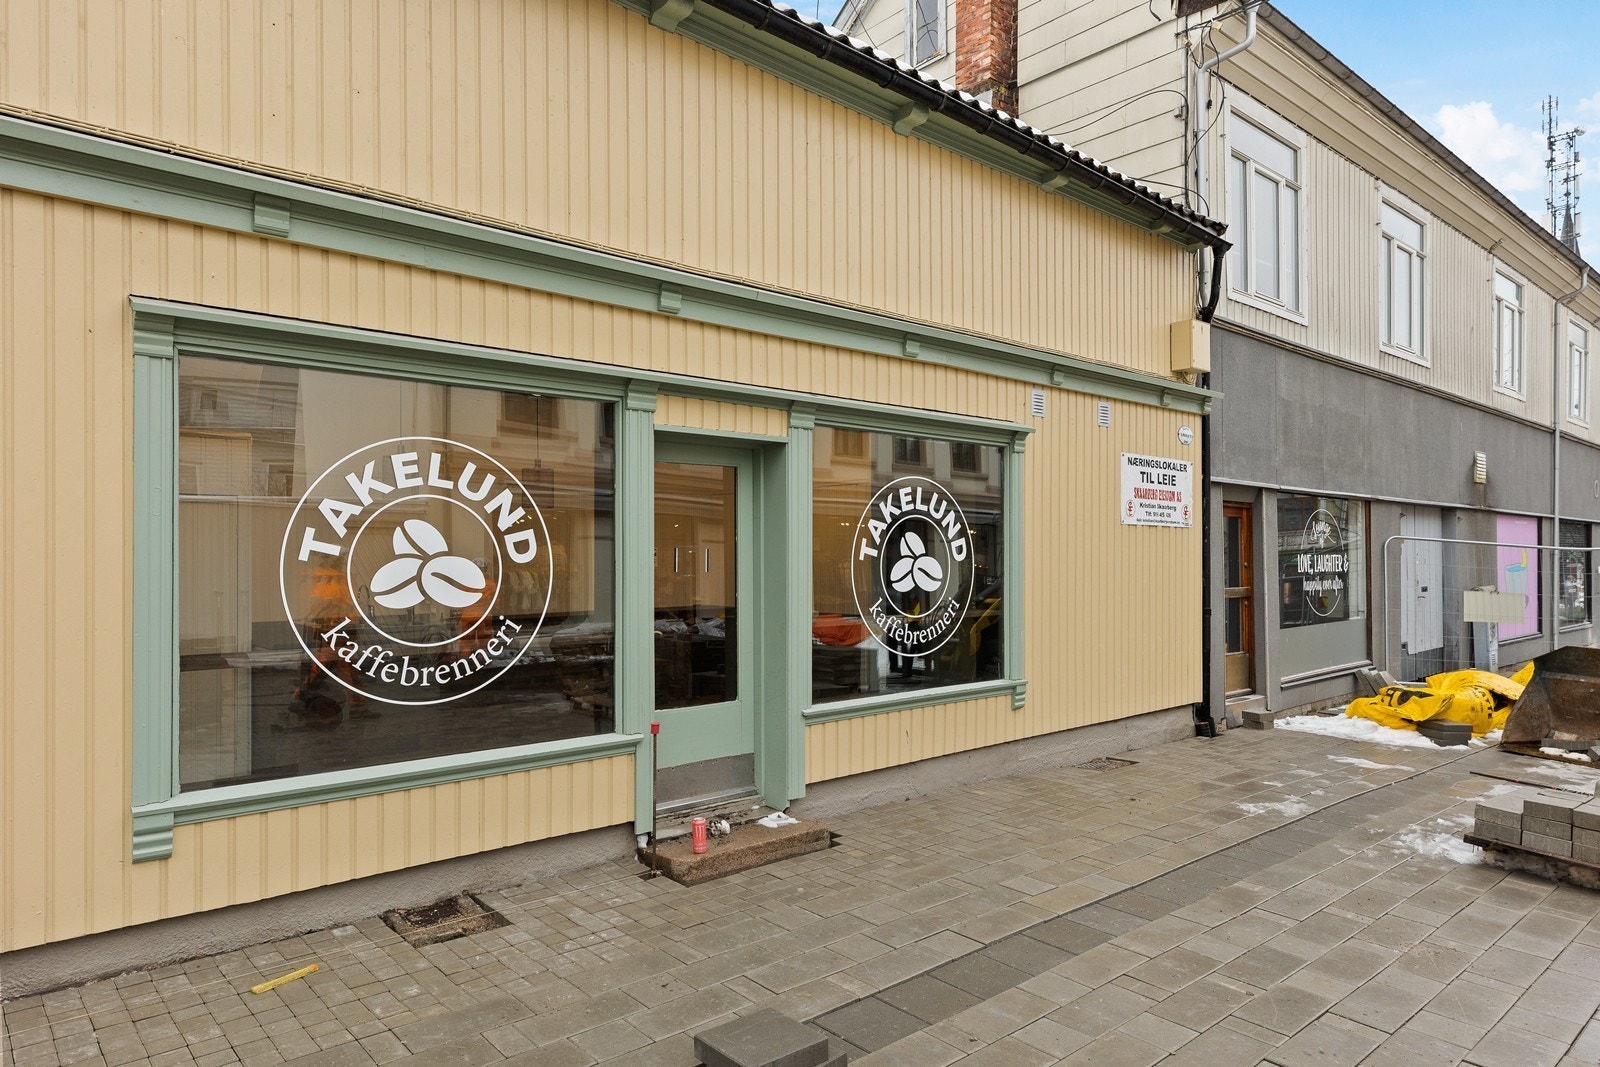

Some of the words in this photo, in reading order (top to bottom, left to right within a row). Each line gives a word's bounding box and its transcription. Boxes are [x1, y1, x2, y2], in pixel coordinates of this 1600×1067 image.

[1127, 456, 1188, 473] NÆRINGSLOKALER
[1140, 471, 1155, 484] TIL
[1157, 473, 1177, 486] LEIE
[298, 451, 537, 564] TAKELUND
[859, 486, 967, 562] TAKELUND
[1297, 553, 1314, 575] LOVE,
[1314, 554, 1343, 573] LAUGHTER
[869, 597, 960, 645] kaffebrenneri
[320, 615, 523, 687] kaffebrenneri
